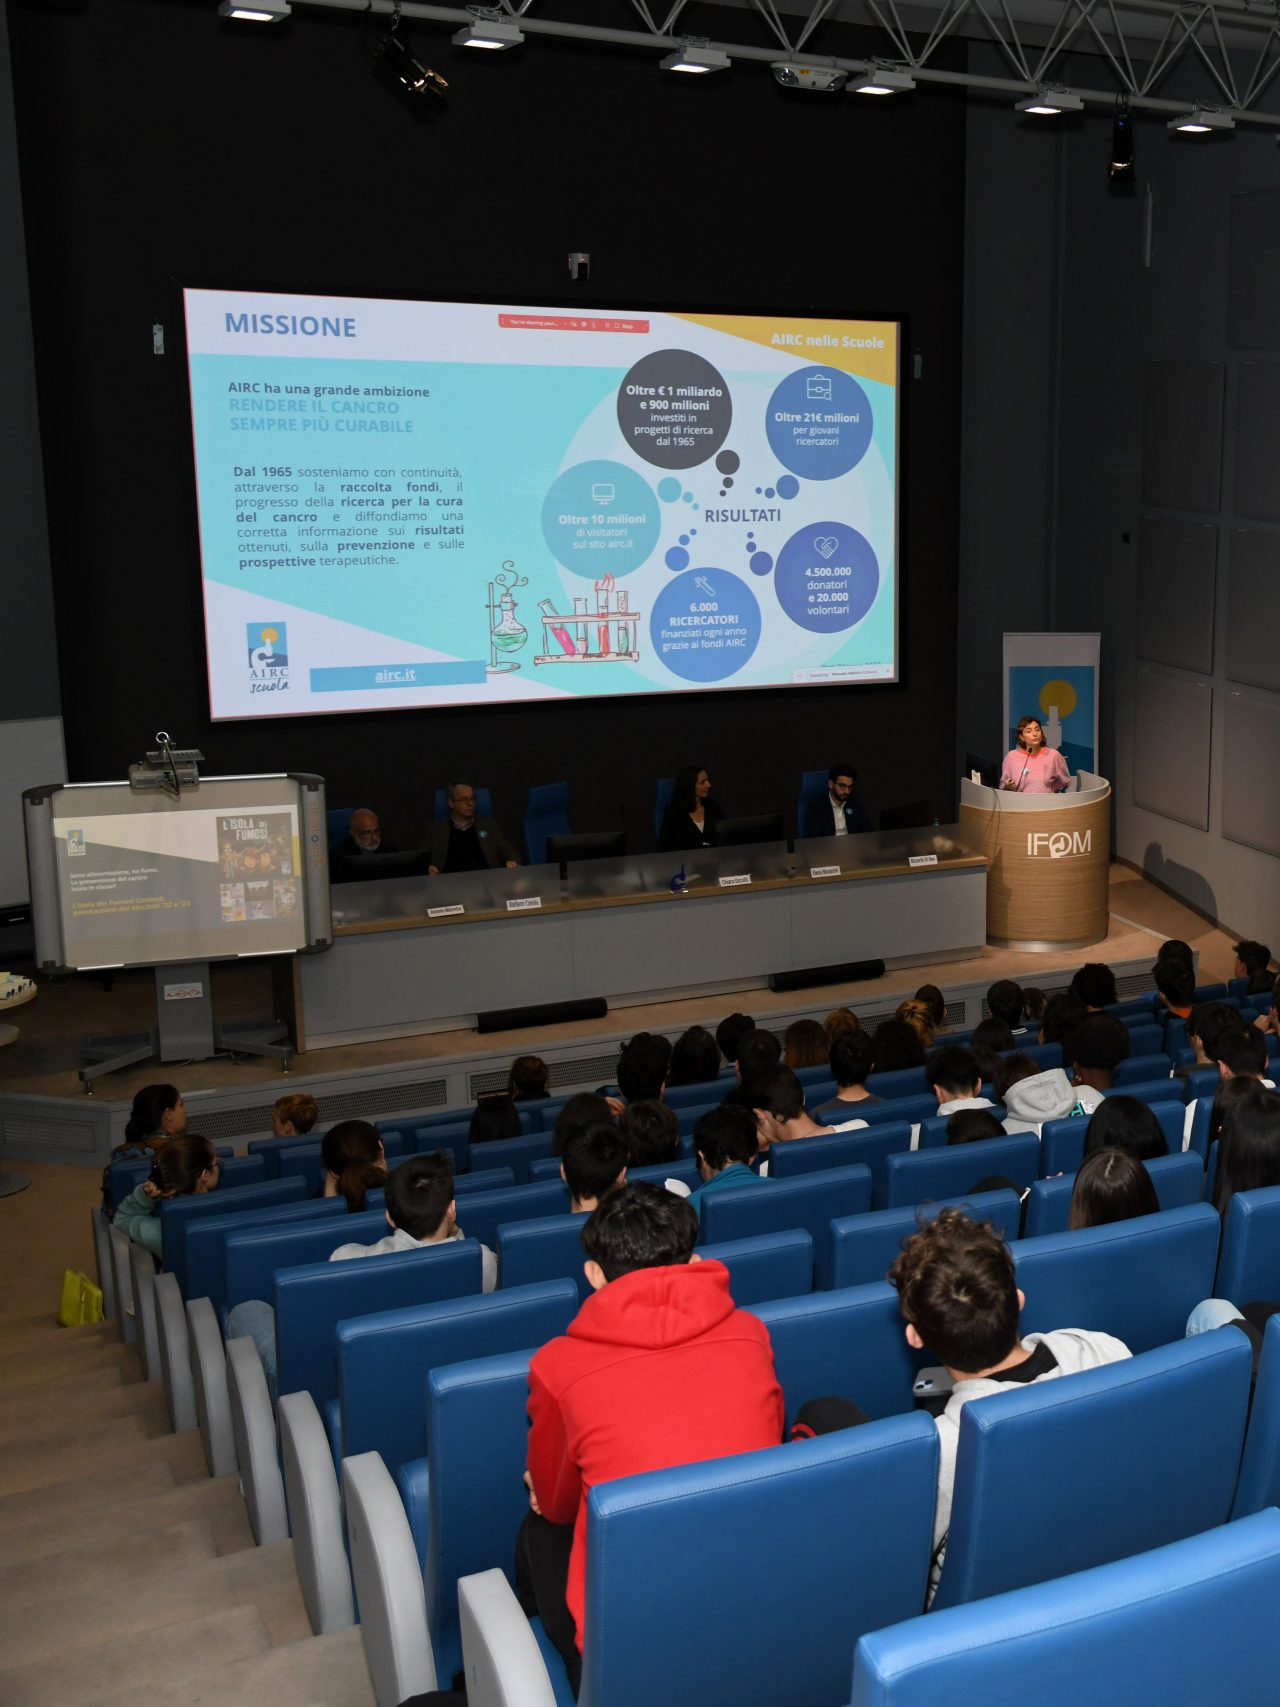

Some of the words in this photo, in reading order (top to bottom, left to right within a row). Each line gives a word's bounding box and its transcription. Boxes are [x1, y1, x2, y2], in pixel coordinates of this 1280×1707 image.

[225, 312, 357, 338] MISSIONE
[771, 333, 803, 347] AIRC
[807, 334, 839, 347] nelle
[842, 335, 884, 349] Scuole
[228, 382, 260, 393] AIRC
[264, 383, 281, 394] ha
[286, 386, 310, 395] una
[314, 385, 360, 399] grande
[363, 385, 430, 398] ambizione
[626, 385, 656, 397] Oltre
[658, 386, 665, 397] €
[668, 386, 673, 397] 1
[677, 386, 723, 397] miliardo
[229, 398, 307, 412] RENDERE
[312, 400, 326, 413] IL
[331, 401, 399, 415] CANCRO
[640, 402, 646, 410] e
[649, 400, 668, 410] 900
[672, 400, 710, 411] milioni
[651, 413, 687, 422] investiti
[689, 414, 697, 422] in
[775, 412, 801, 423] Oltre
[803, 412, 822, 423] 21€
[825, 413, 860, 423] milioni
[230, 417, 296, 431] SEMPRE
[303, 416, 329, 432] PIÙ
[335, 419, 413, 434] CURABILE
[634, 424, 670, 437] progetti
[673, 425, 682, 435] di
[684, 426, 713, 435] ricerca
[793, 426, 807, 436] per
[810, 425, 839, 436] giovani
[656, 436, 670, 446] dal
[672, 436, 695, 446] 1965
[796, 436, 839, 446] ricercatori
[233, 466, 256, 477] Dal
[262, 467, 292, 477] 1965
[298, 467, 369, 478] sosteniamo
[374, 469, 396, 478] con
[235, 482, 299, 492] attraverso
[315, 482, 325, 492] la
[340, 482, 392, 492] raccolta
[407, 482, 442, 494] fondi,
[457, 482, 463, 492] il
[236, 498, 298, 510] progresso
[305, 497, 334, 507] della
[341, 497, 385, 507] ricerca
[391, 498, 413, 510] per
[419, 496, 430, 507] la
[436, 498, 463, 507] cura
[236, 512, 257, 523] del
[273, 513, 318, 522] cancro
[333, 513, 340, 522] e
[355, 511, 427, 522] diffondiamo
[442, 513, 464, 521] una
[558, 514, 588, 525] Oltre
[607, 513, 646, 524] milioni
[705, 509, 781, 523] RISULTATI
[237, 527, 287, 538] corretta
[298, 526, 378, 537] informazione
[388, 526, 405, 536] sui
[415, 525, 464, 536] risultati
[576, 527, 585, 537] di
[587, 527, 627, 537] visitatori
[238, 542, 291, 553] ottenuti,
[300, 540, 328, 551] sulla
[337, 540, 415, 553] prevenzione
[423, 541, 431, 550] e
[438, 539, 465, 550] sulle
[239, 556, 316, 570] prospettive
[320, 554, 399, 568] terapeutiche.
[805, 566, 852, 577] 4.500.000
[807, 580, 847, 590] donatori
[809, 595, 815, 603] e
[817, 592, 849, 603] 20.000
[690, 602, 718, 613] 6.000
[808, 604, 849, 615] volontari
[669, 614, 739, 626] RICERCATORI
[661, 628, 701, 639] finanziati
[704, 629, 722, 640] ogni
[725, 628, 747, 637] anno
[662, 640, 689, 652] grazie
[691, 640, 698, 649] ai
[700, 639, 724, 649] fondi
[726, 638, 746, 648] AIRC
[250, 667, 290, 679] AIRC
[376, 668, 416, 681] airc.it
[250, 677, 290, 694] scuola
[1027, 830, 1092, 856] IFOM
